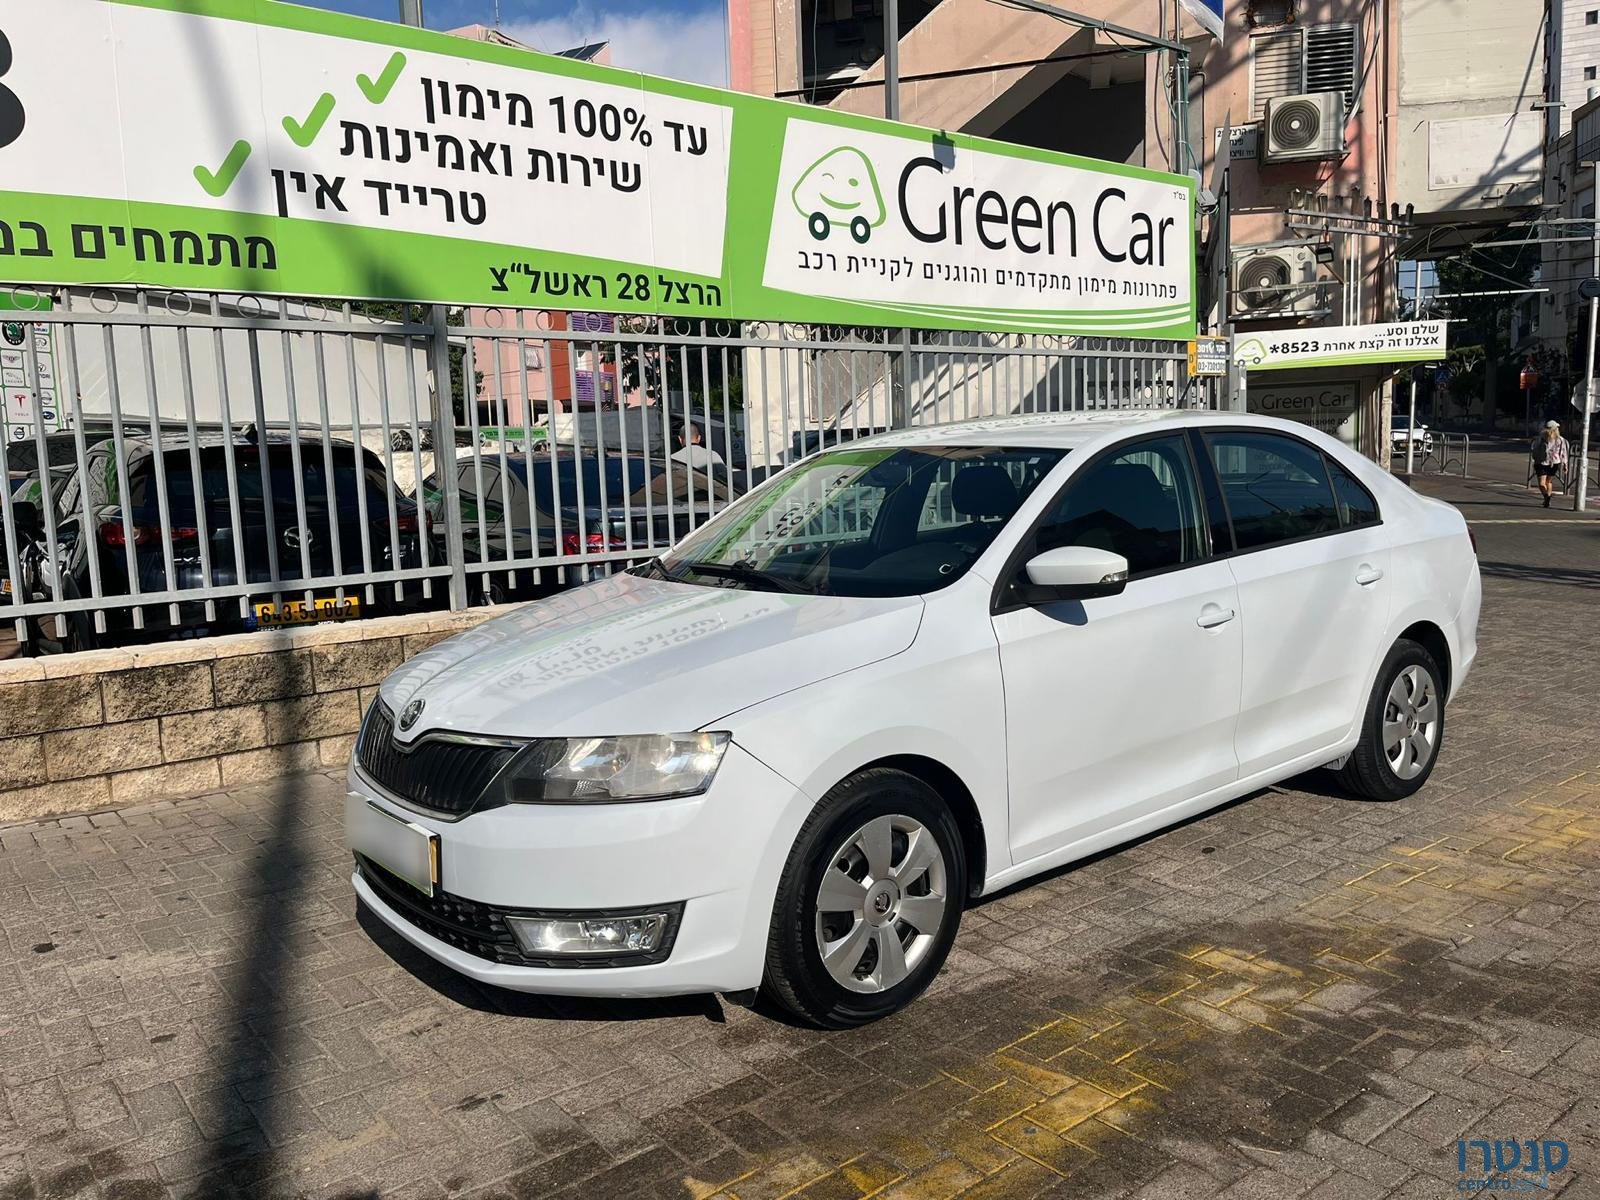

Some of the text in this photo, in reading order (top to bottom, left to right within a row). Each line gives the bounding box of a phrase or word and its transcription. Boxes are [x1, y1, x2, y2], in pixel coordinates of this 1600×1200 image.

[420, 77, 708, 156] עד 100% מימון
[339, 120, 642, 193] שירות ואמינות
[271, 168, 488, 225] טרייד אין
[898, 156, 1174, 267] Green Car
[71, 223, 278, 270] מתמחים
[616, 272, 650, 301] 28
[798, 250, 1177, 299] פתרונות מימון מתקדמים והוגנים לקניית רכב
[658, 274, 722, 307] הרצל
[1359, 340, 1384, 350] קצת
[1388, 338, 1401, 347] זה
[1405, 335, 1439, 346] אצלנו
[1412, 324, 1439, 335] שלם
[1323, 341, 1355, 352] אחרת
[1261, 391, 1350, 410] Green Car
